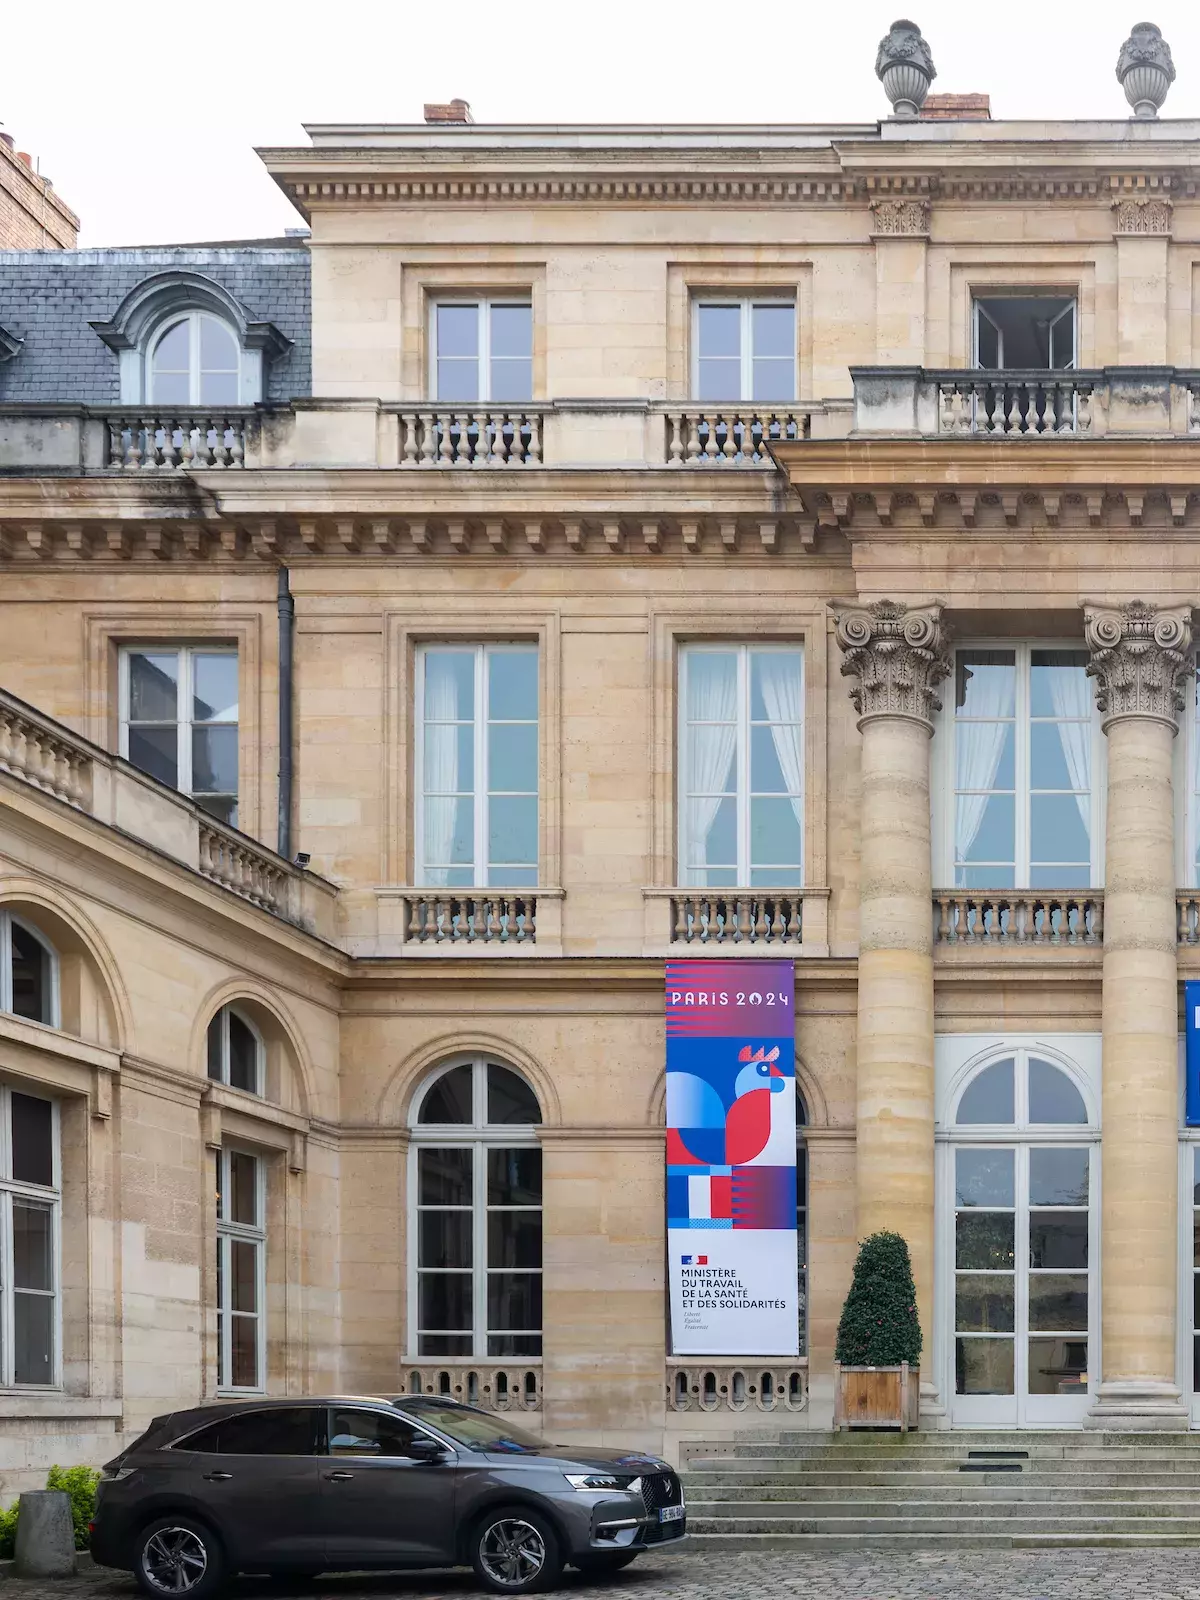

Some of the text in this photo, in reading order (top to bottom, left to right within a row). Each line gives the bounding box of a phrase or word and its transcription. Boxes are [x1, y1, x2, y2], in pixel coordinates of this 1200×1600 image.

[736, 992, 788, 1006] 2024
[681, 1268, 736, 1277] MINISTÈRE
[715, 1288, 748, 1298] SANTÉ
[698, 1300, 717, 1308] DES
[720, 1299, 786, 1309] SOLIDARITÉS
